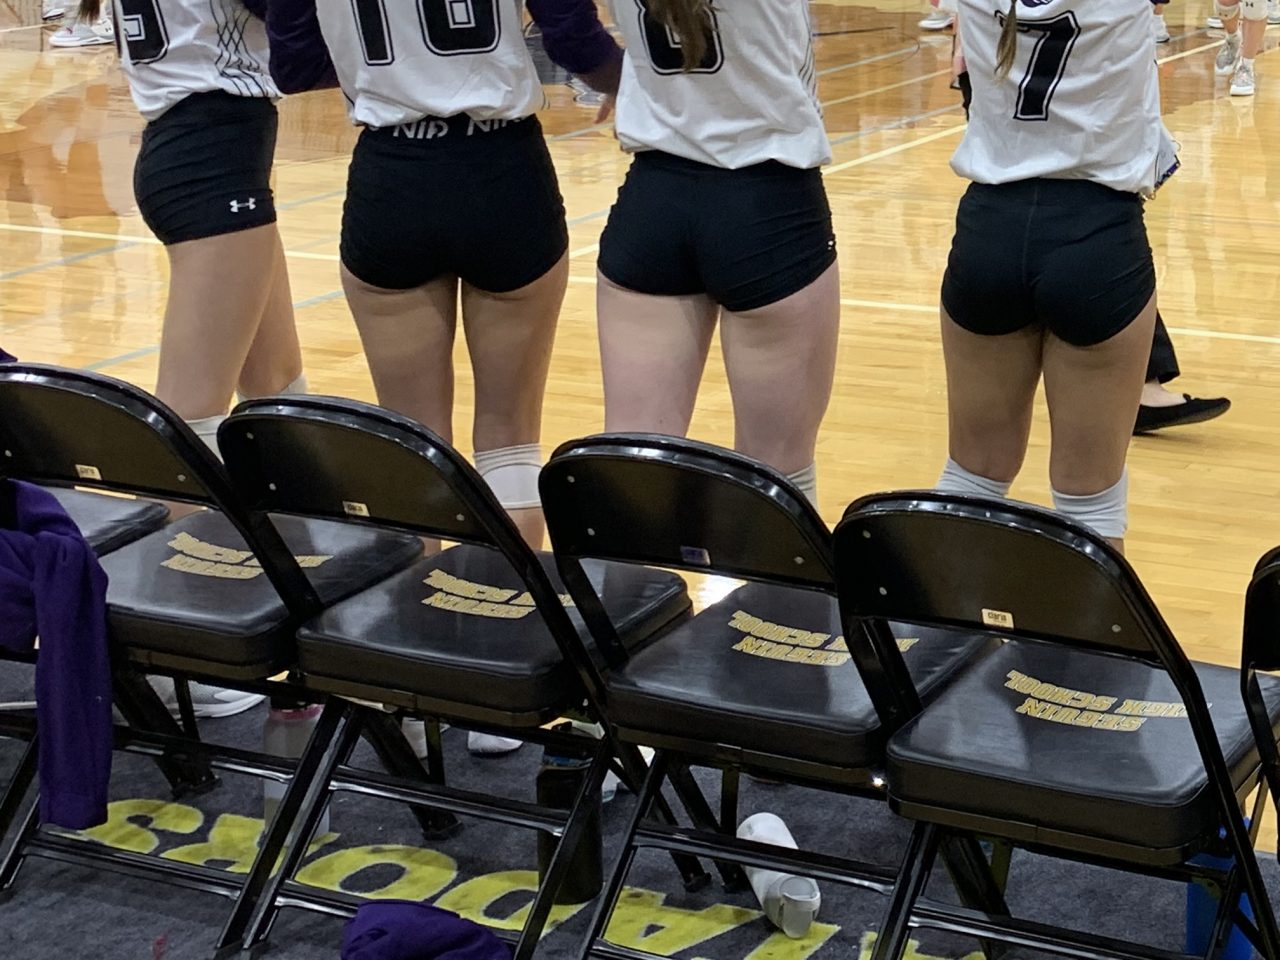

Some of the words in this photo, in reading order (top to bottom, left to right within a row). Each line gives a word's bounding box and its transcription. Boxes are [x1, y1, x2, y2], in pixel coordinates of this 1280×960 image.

[994, 10, 1081, 121] 7
[1004, 670, 1118, 710] SCHOOL
[1015, 697, 1148, 732] SEGUIN
